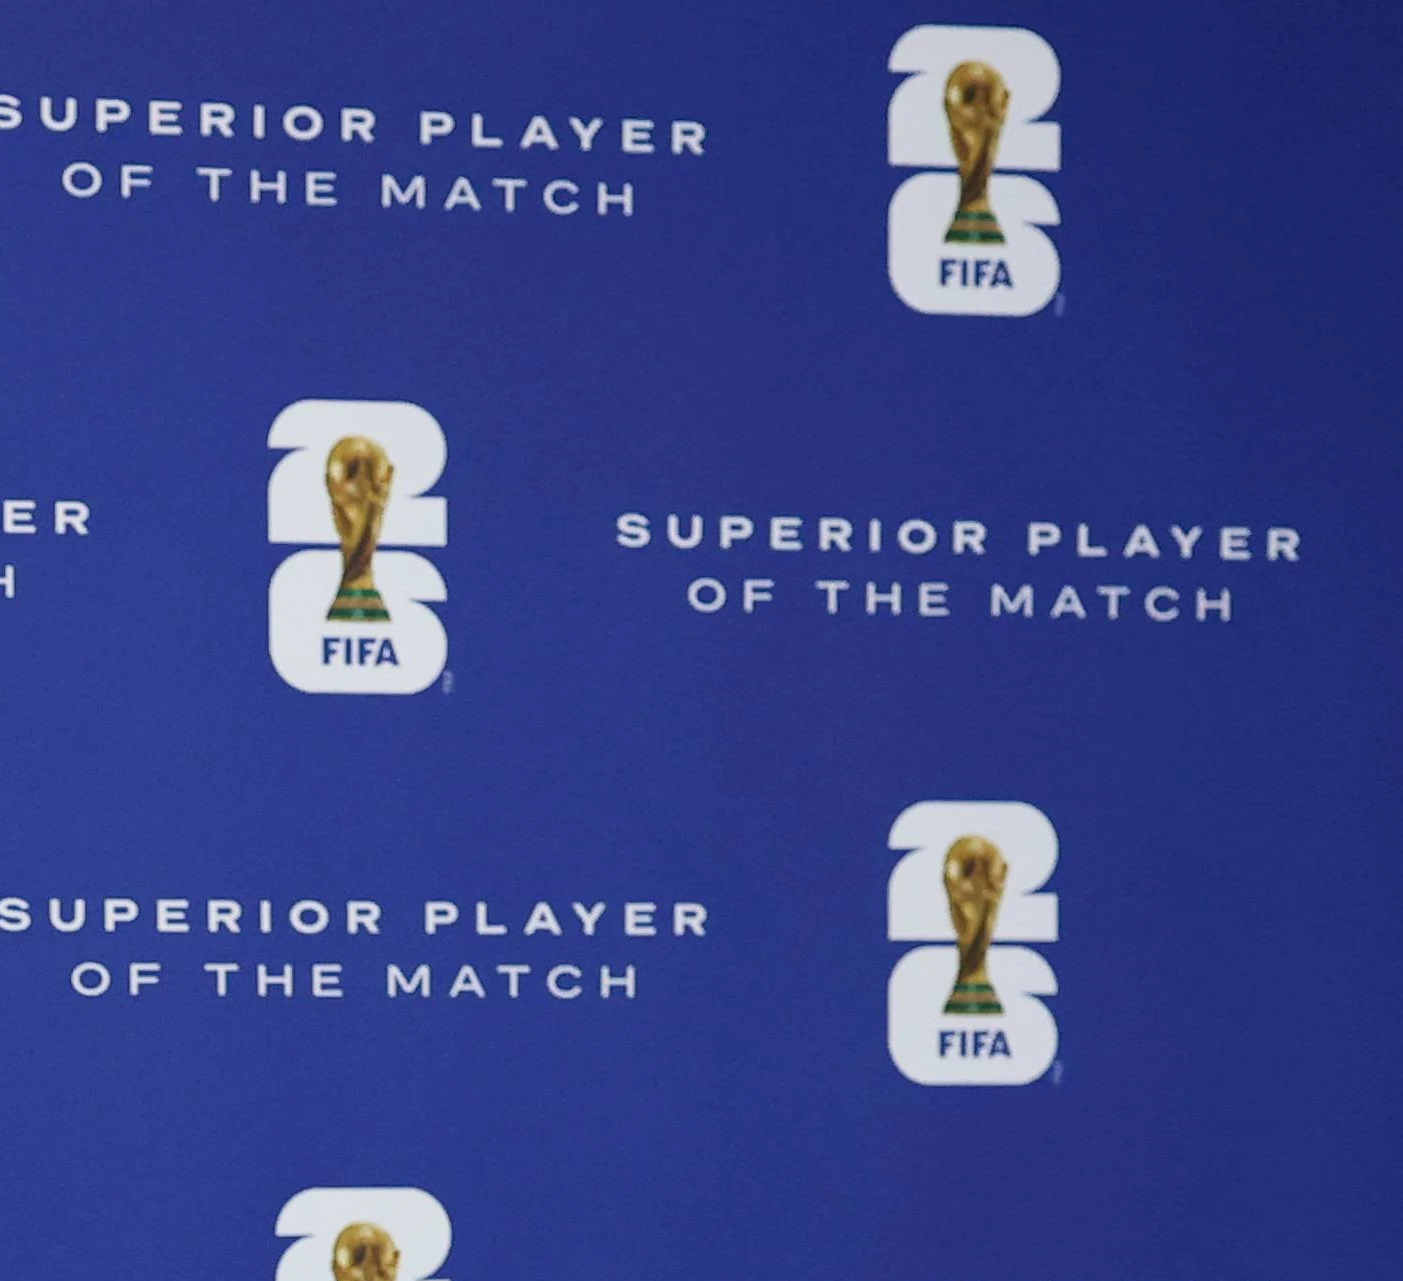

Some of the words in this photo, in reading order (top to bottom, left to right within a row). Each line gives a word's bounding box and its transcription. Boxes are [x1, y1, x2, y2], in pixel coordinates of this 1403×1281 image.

[419, 110, 706, 156] PLAYER
[61, 161, 154, 199] OF
[195, 166, 339, 207] THE
[380, 173, 634, 217] MATCH
[615, 512, 988, 556] SUPERIOR
[1027, 521, 1301, 562] PLAYER
[686, 577, 775, 614] OF
[814, 579, 951, 617] THE
[990, 582, 1231, 623] MATCH
[321, 636, 400, 667] FIFA
[424, 900, 708, 937] PLAYER
[70, 961, 162, 997] OF
[202, 962, 344, 998] THE
[386, 963, 636, 1000] MATCH
